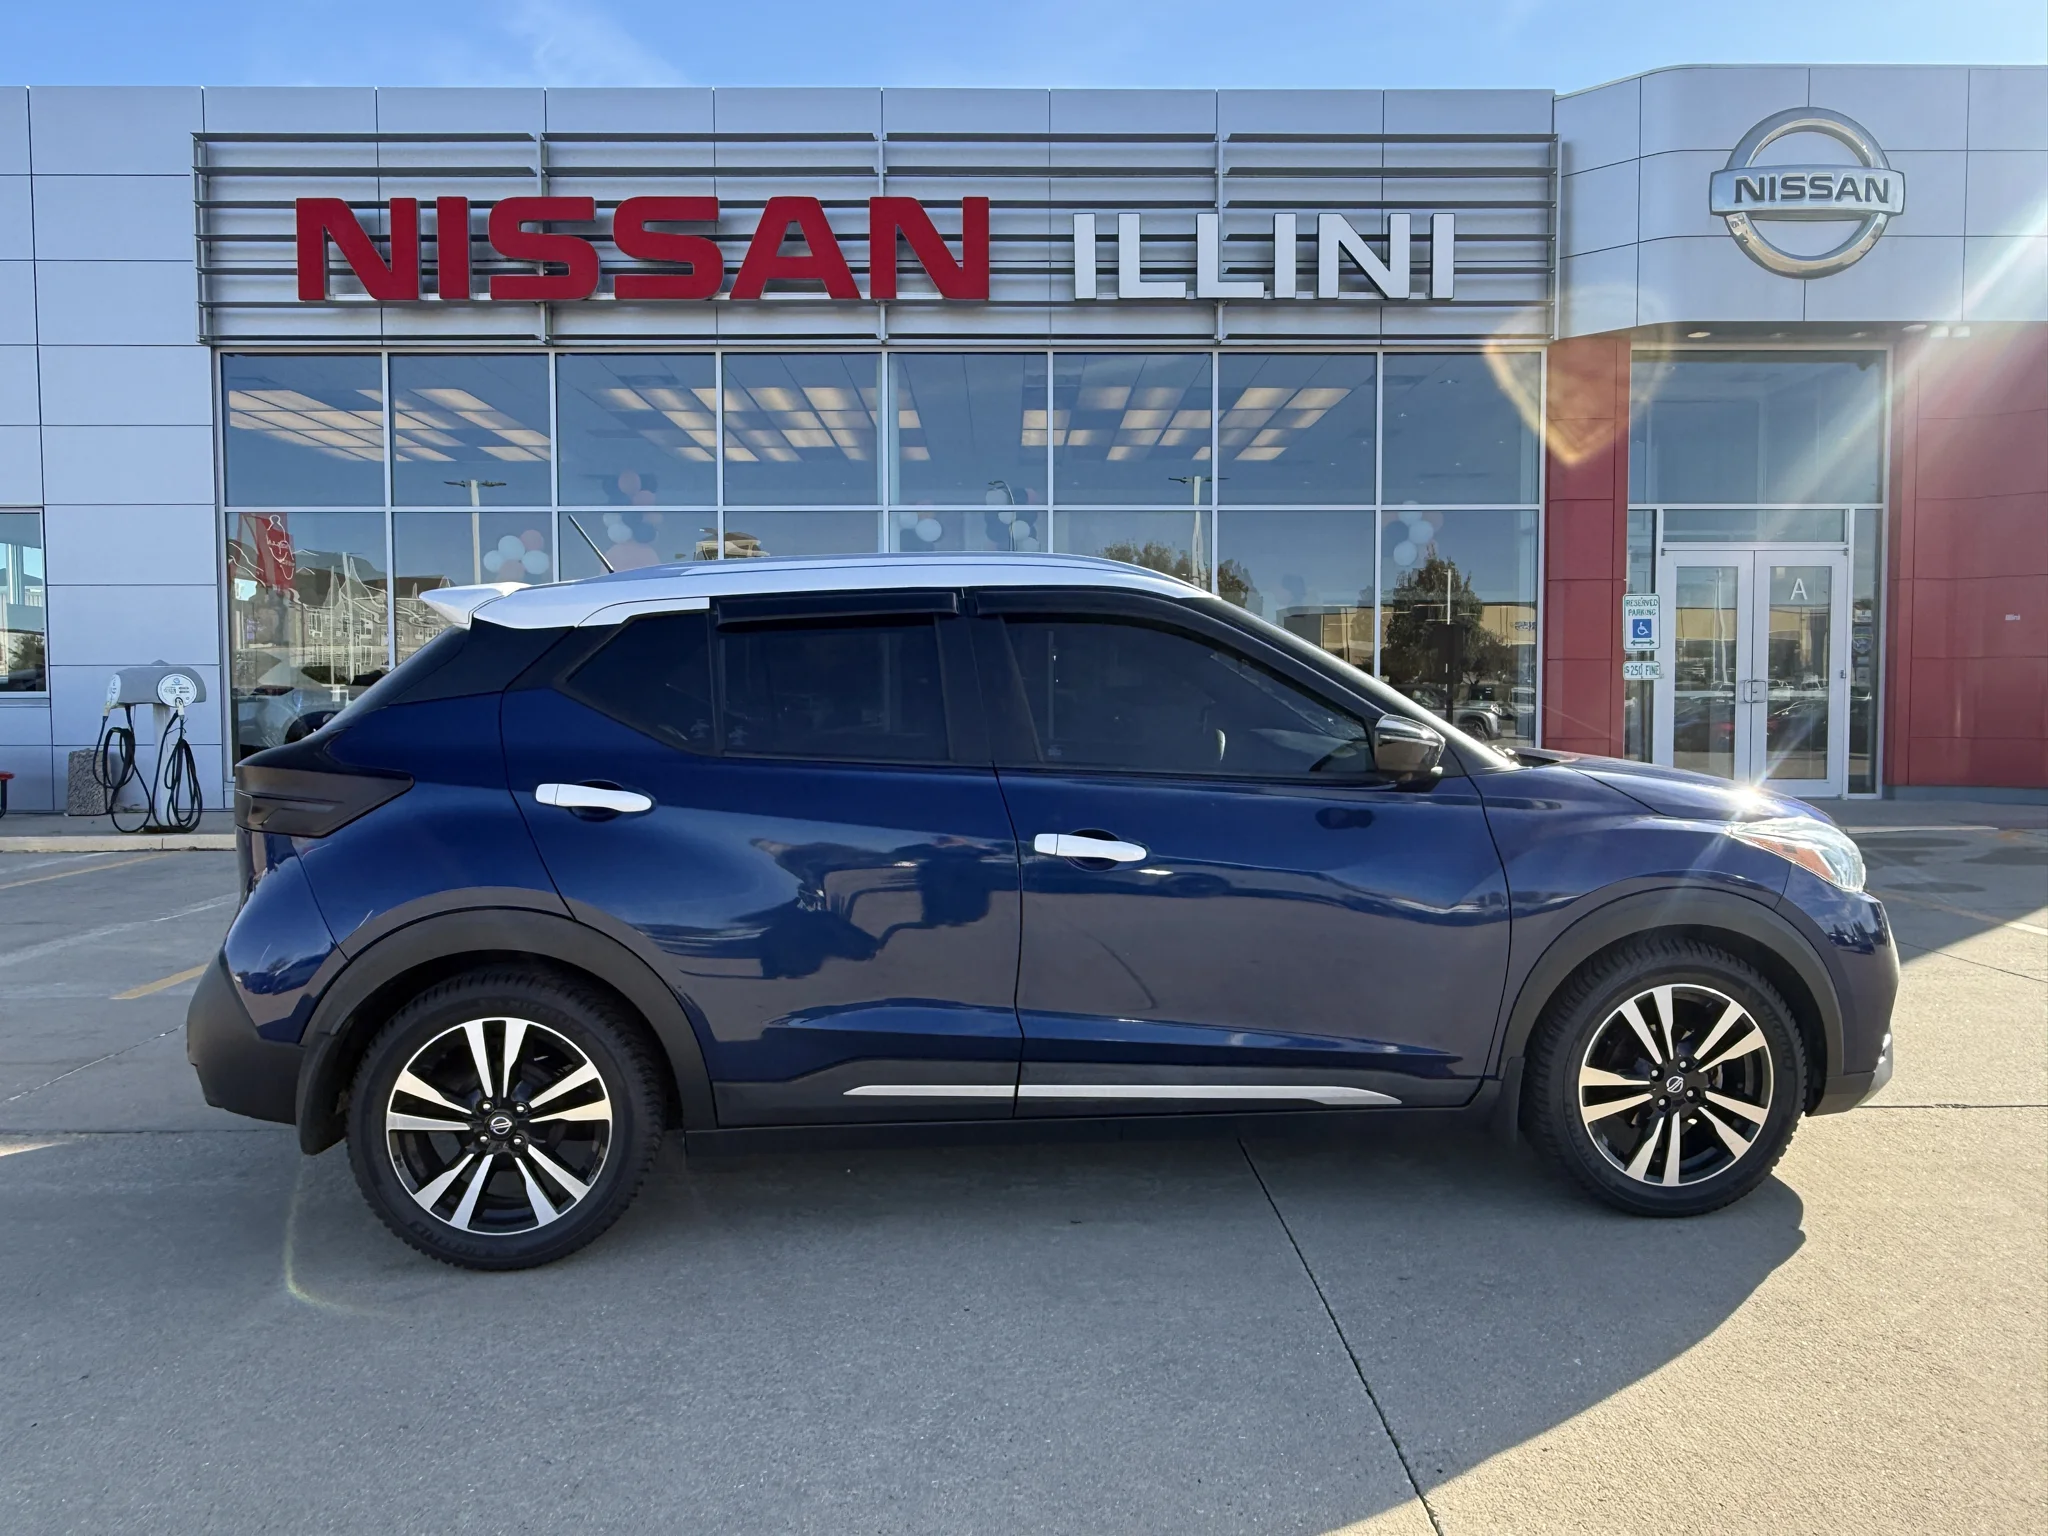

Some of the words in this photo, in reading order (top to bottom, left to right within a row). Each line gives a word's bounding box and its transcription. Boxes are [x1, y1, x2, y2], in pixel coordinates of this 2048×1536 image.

[1733, 174, 1890, 204] NISSAN
[296, 196, 990, 301] NISSAN
[1073, 212, 1456, 300] ILLINI
[1790, 577, 1808, 600] A
[1625, 599, 1659, 607] RESERVED
[1628, 608, 1657, 617] PARKING
[1645, 664, 1660, 676] FINE
